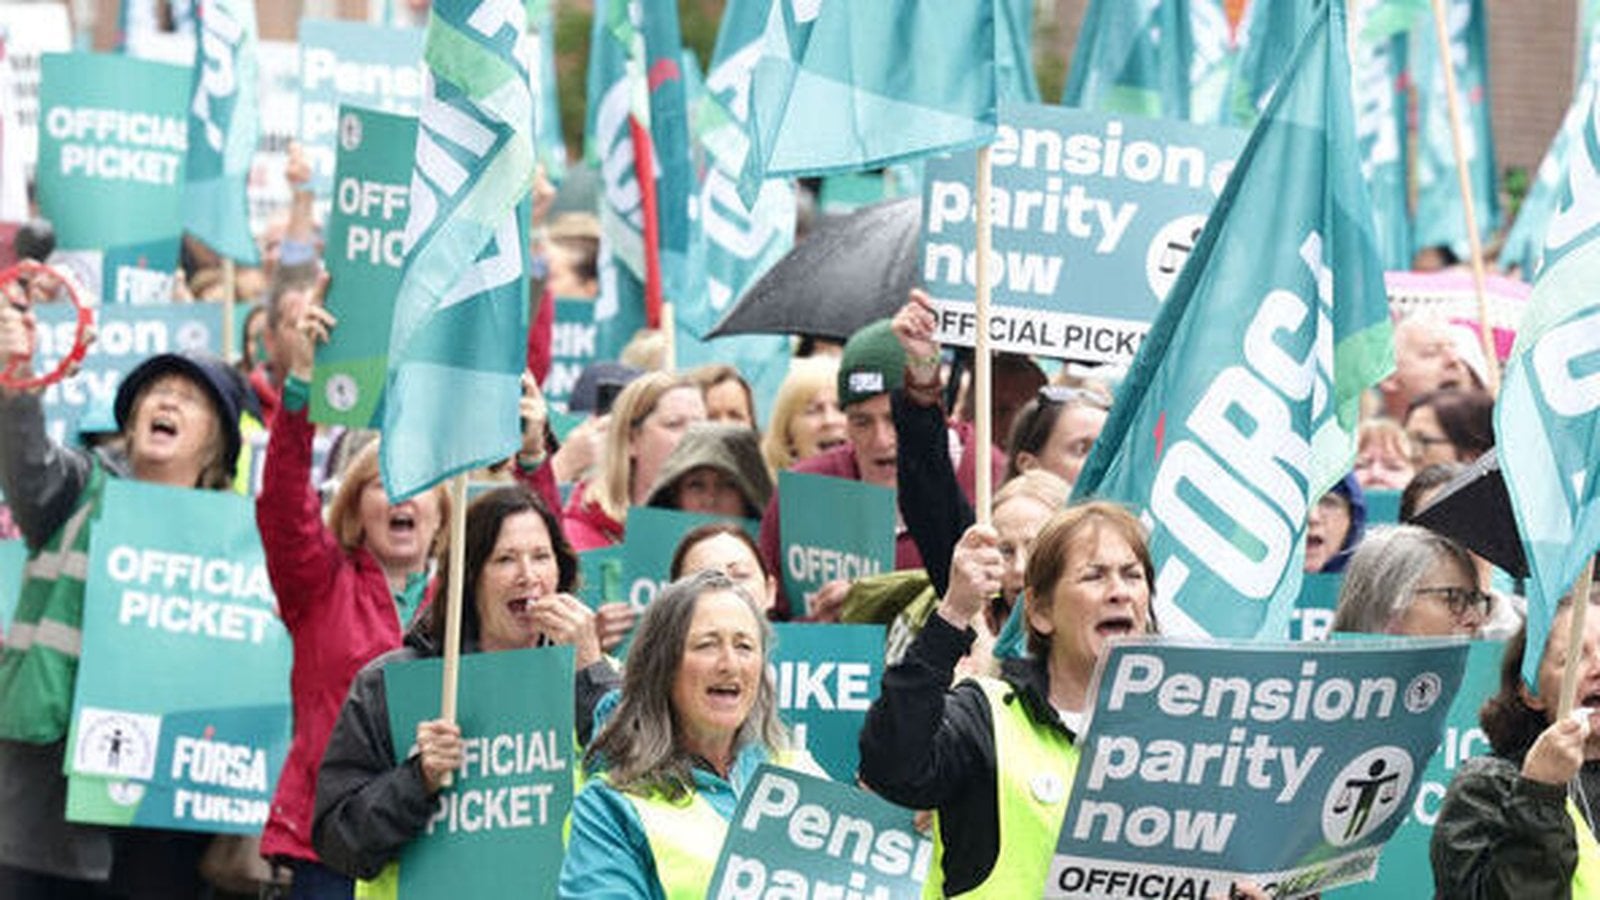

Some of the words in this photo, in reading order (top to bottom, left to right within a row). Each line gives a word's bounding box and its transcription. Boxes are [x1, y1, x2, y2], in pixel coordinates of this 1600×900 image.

[303, 47, 419, 96] Pens
[47, 105, 188, 151] OFFICIA
[989, 120, 1206, 188] ension
[61, 143, 179, 184] PICKET
[928, 176, 1139, 255] parity
[347, 225, 405, 268] PIC
[924, 241, 1064, 295] now
[932, 309, 1056, 347] FFCIAL
[1064, 325, 1147, 356] PICK
[107, 545, 277, 602] OFFICIA
[119, 590, 276, 643] PICKET
[768, 661, 872, 711] IKE
[1107, 653, 1397, 722] Pension
[409, 729, 567, 779] FICIAL
[1086, 726, 1324, 803] parity
[426, 784, 553, 835] PICKET
[742, 772, 934, 882] Pensi
[1072, 800, 1237, 853] now
